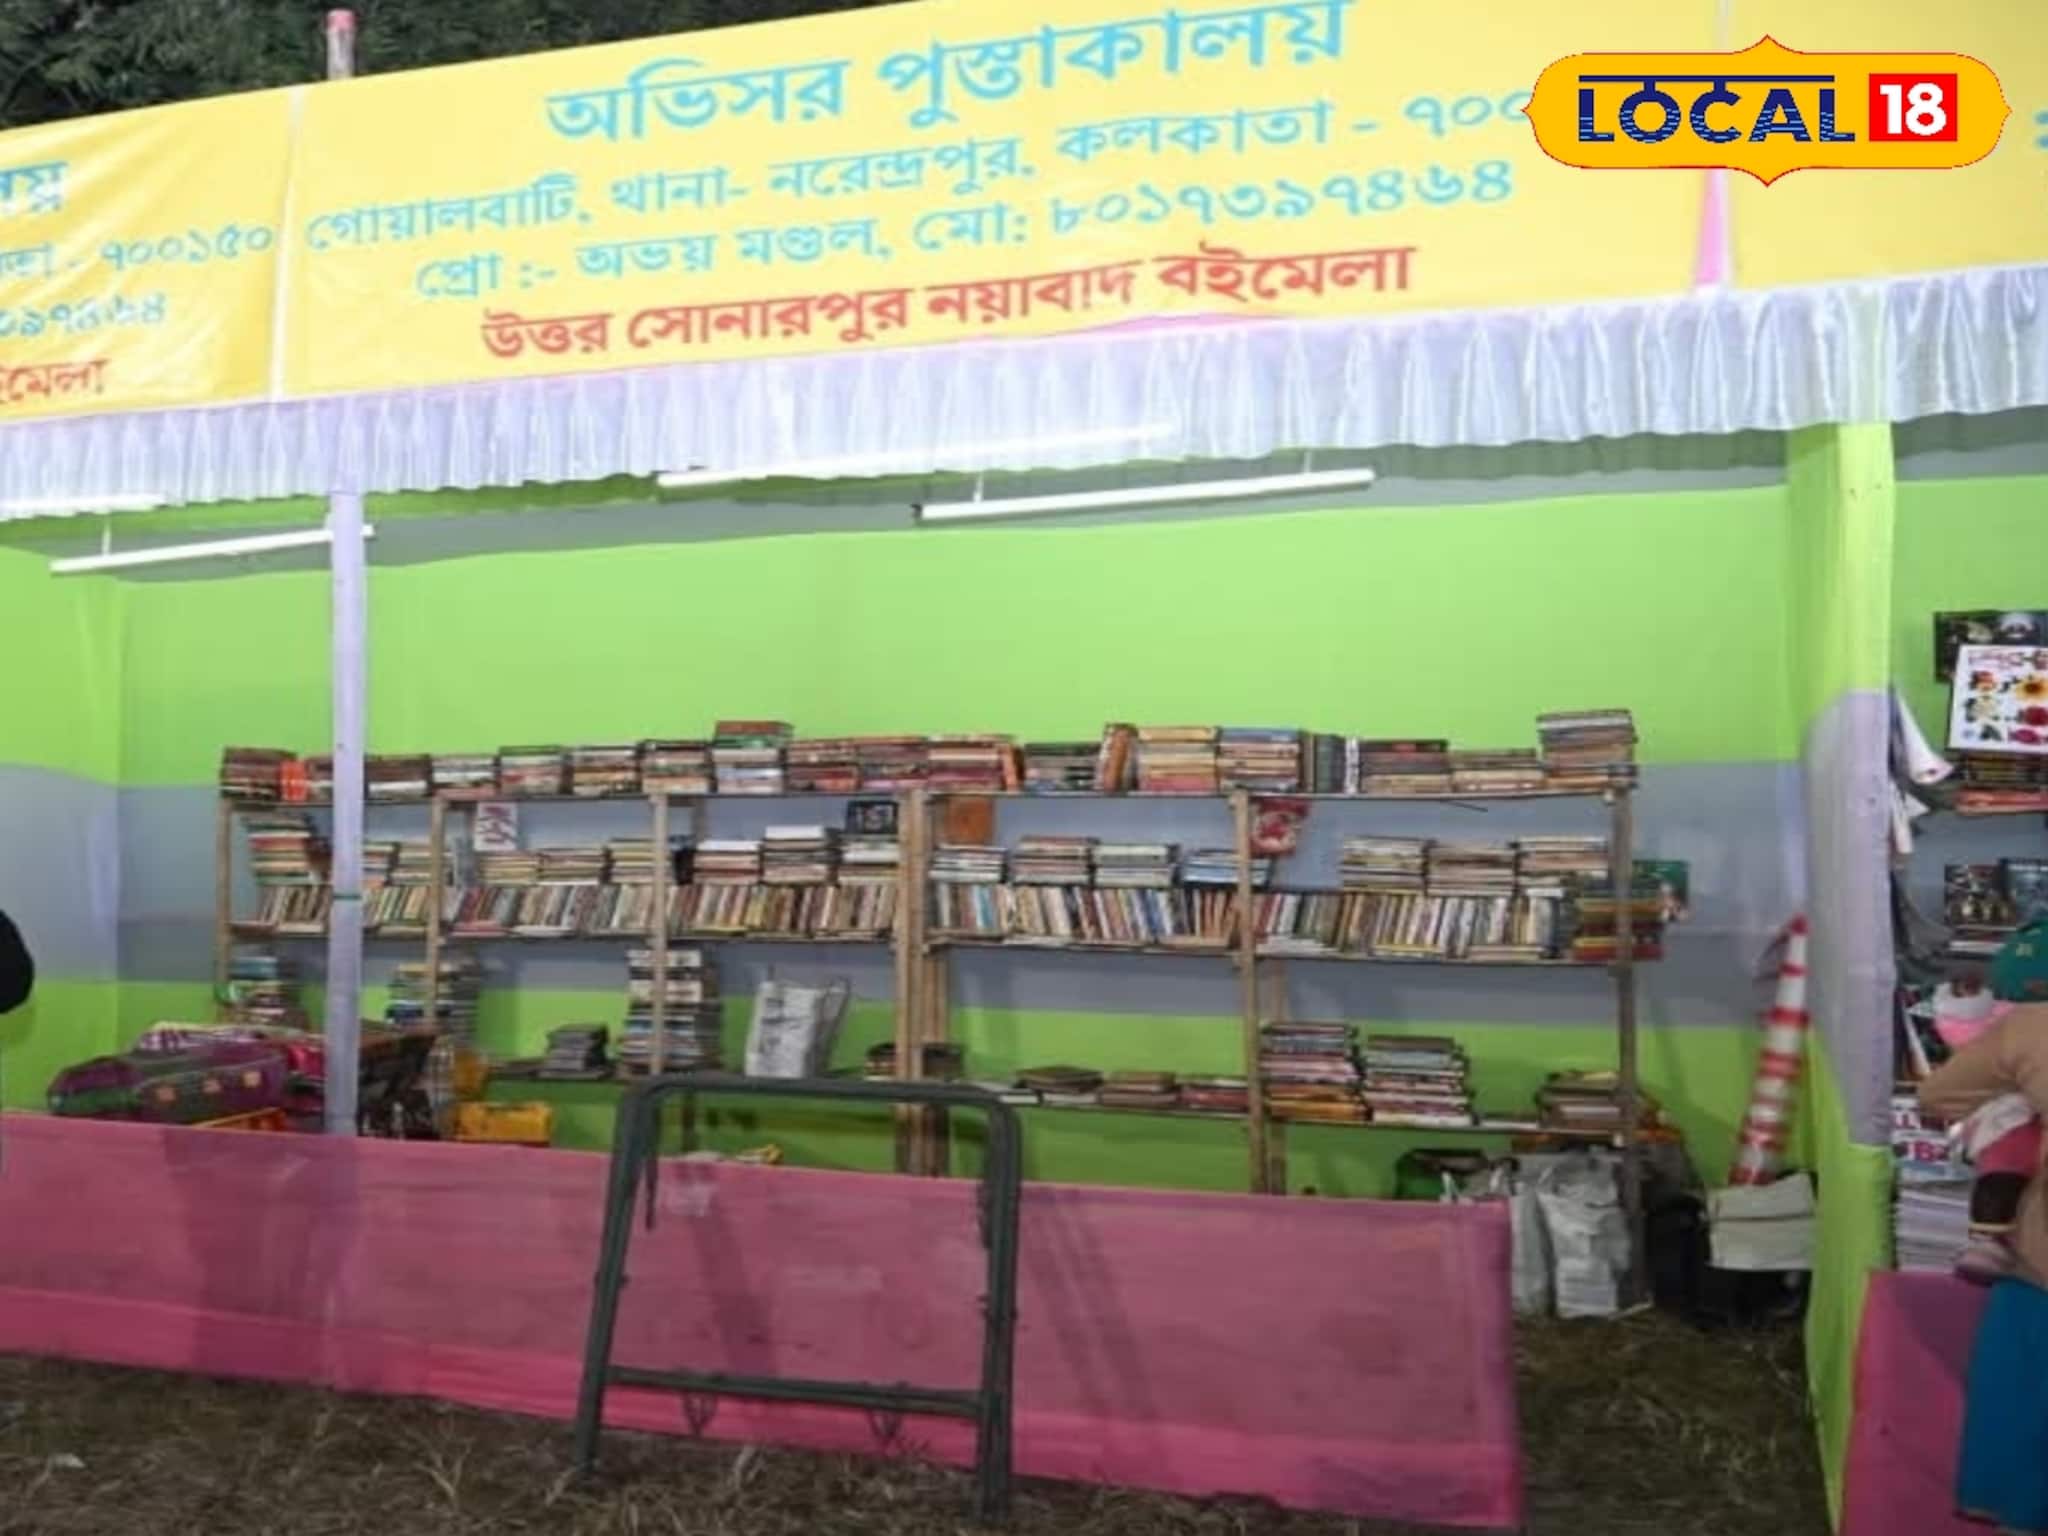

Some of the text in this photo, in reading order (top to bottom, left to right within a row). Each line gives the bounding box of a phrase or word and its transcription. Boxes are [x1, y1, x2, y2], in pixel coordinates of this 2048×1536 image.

[546, 0, 1354, 141] অভিসর পুস্তাকালয়
[0, 161, 68, 210] য়
[610, 166, 749, 211] থানা-
[1056, 99, 1335, 161] কলকাতা
[101, 223, 273, 270] ৭০০১৫০
[417, 252, 503, 296] প্রো
[576, 234, 718, 276] অভয়
[914, 202, 1027, 250] মো:
[1050, 160, 1513, 233] ৮০১৭৩৯৭৪৬৪
[481, 241, 1417, 359] উত্তর সোনারপুর নয়াবাদ বইমেলা
[0, 357, 110, 402] মেলা
